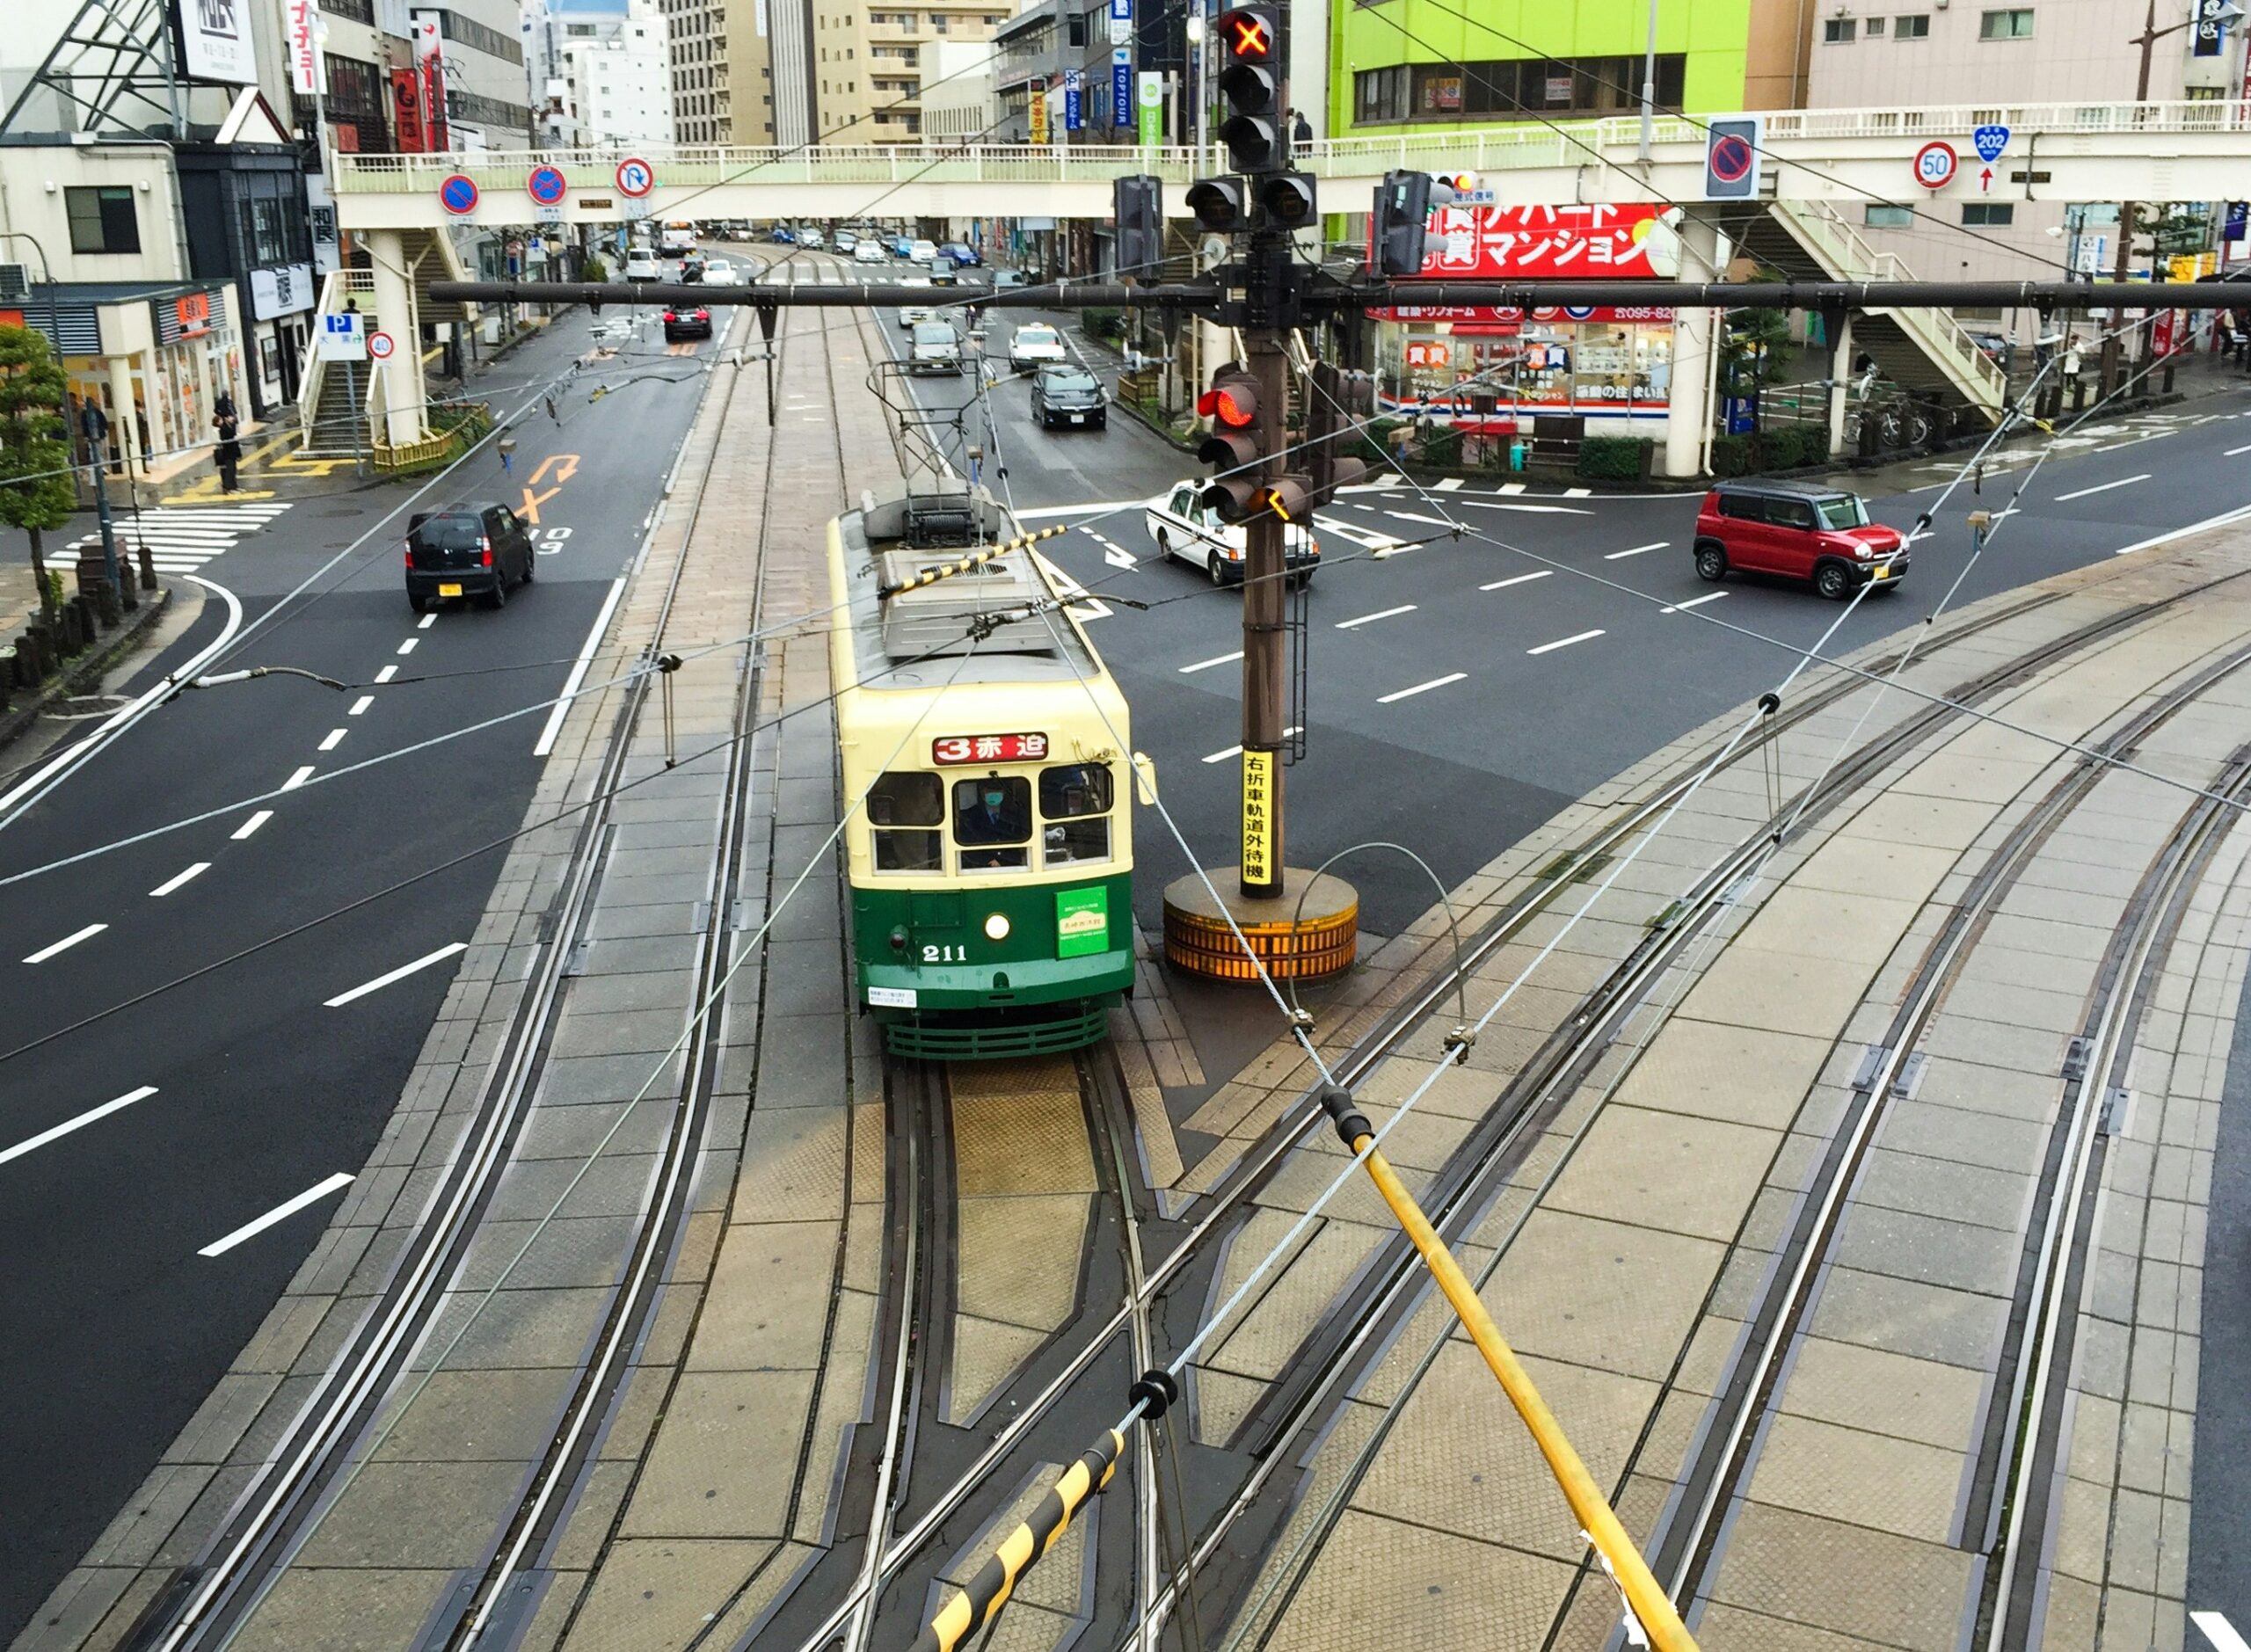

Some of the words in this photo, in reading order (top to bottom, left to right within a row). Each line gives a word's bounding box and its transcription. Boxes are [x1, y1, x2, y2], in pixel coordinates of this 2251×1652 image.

[1118, 68, 1126, 123] TOPTOUR
[1978, 135, 2006, 149] 202
[1923, 154, 1948, 175] 50
[1482, 229, 1649, 267] マンション
[333, 317, 346, 332] P
[375, 339, 389, 351] 40
[1246, 756, 1264, 878] 右折車軌道外待機
[922, 944, 966, 962] 211
